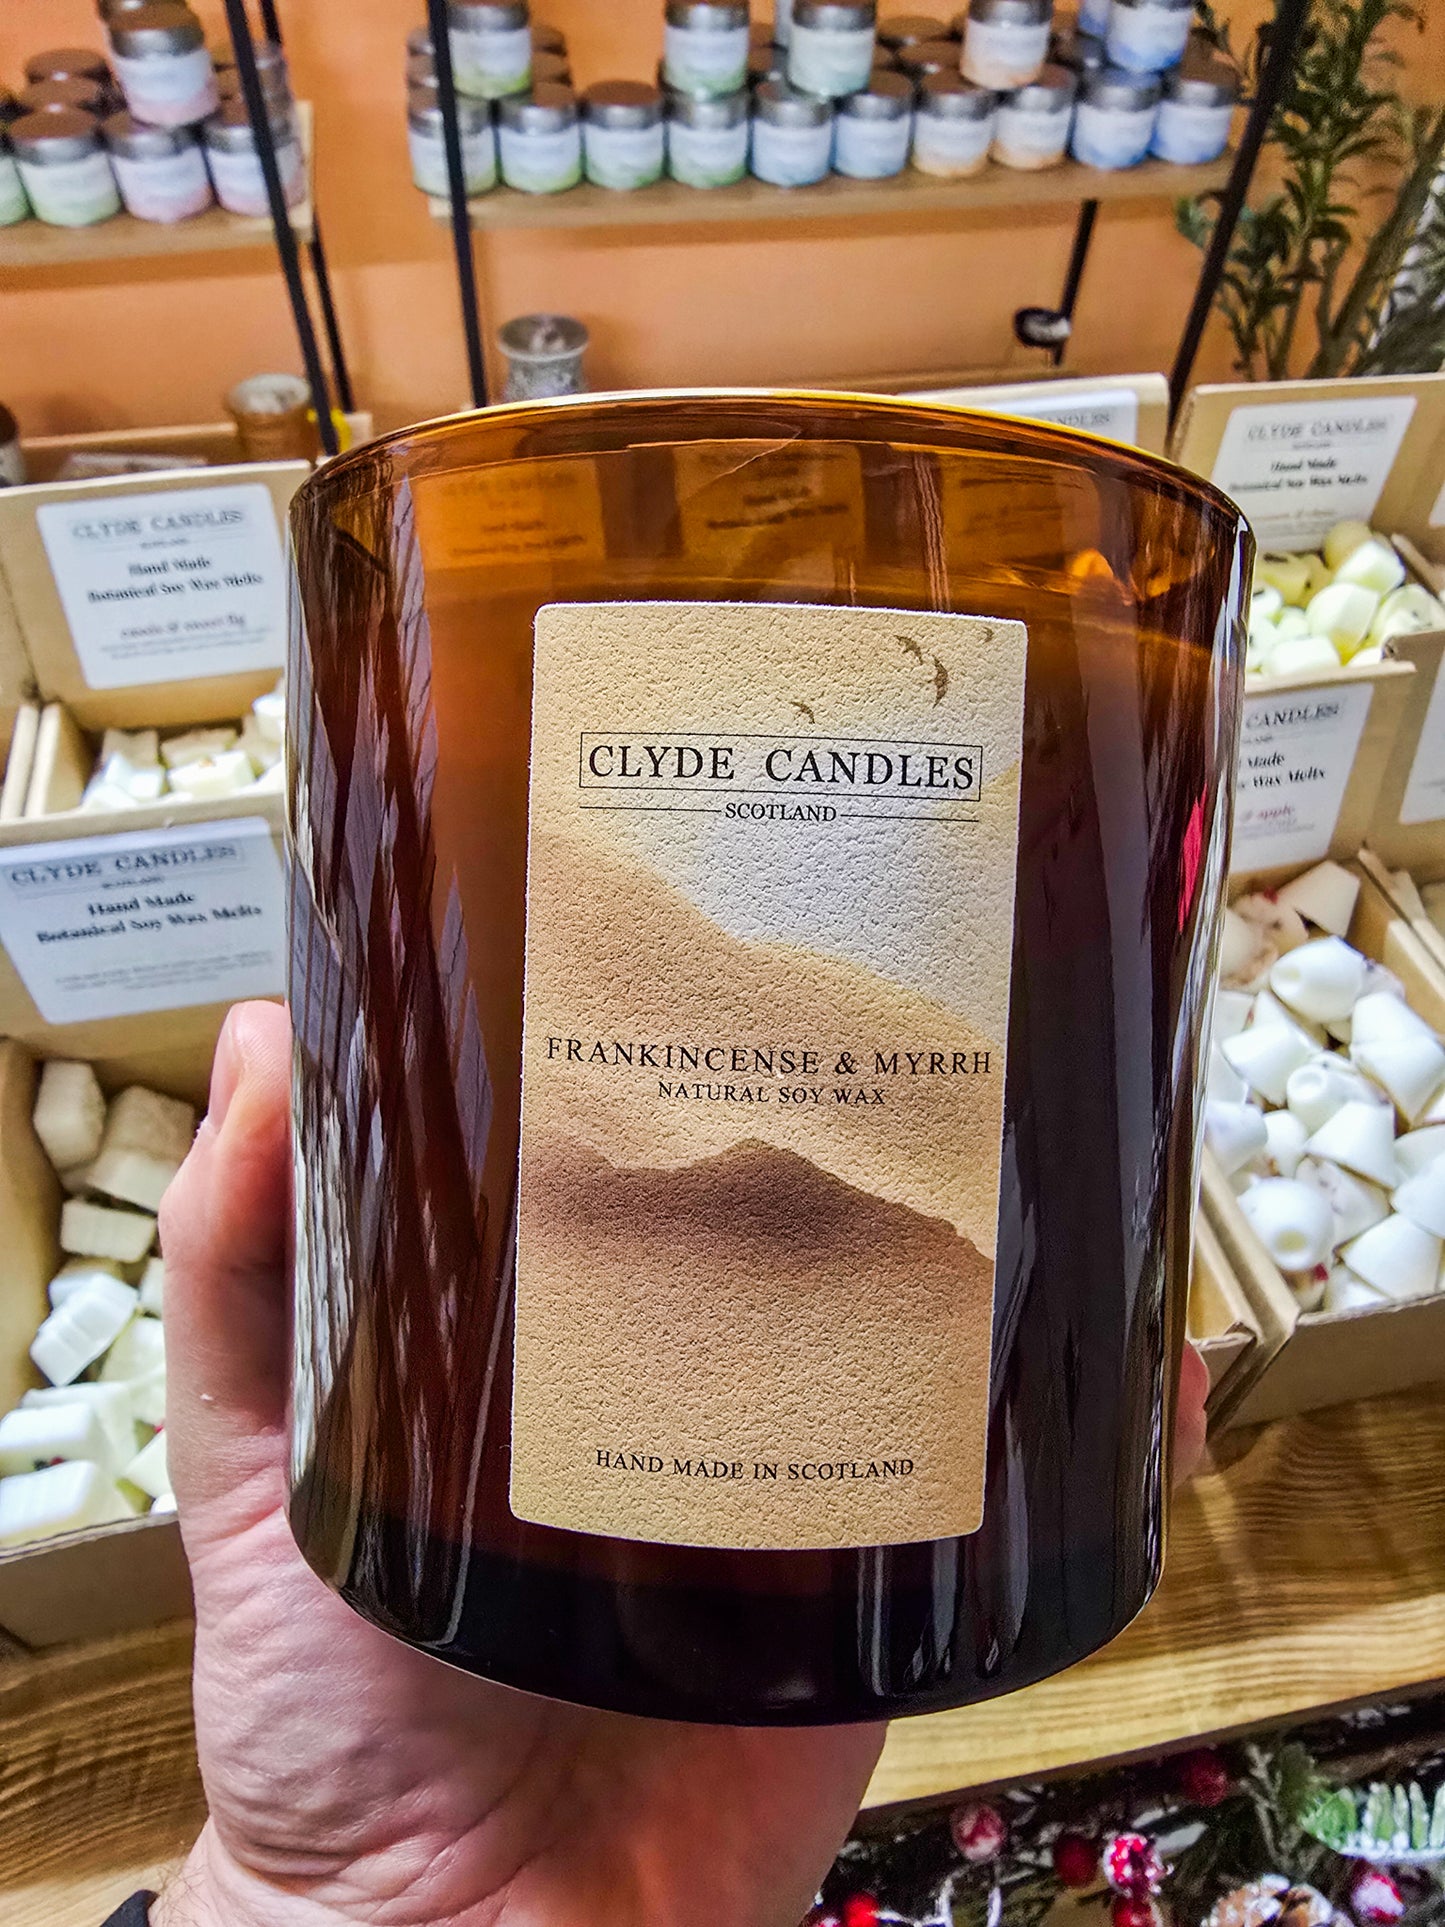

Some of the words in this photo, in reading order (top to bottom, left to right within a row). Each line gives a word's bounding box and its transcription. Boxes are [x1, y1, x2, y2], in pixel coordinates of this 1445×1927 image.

[71, 518, 142, 540] CLYDE
[151, 509, 244, 531] CANDLES
[1245, 702, 1340, 729] CANDLES
[589, 745, 735, 779] CLYDE
[765, 749, 974, 790] CANDLES
[1252, 774, 1281, 789] Wax
[1288, 766, 1326, 783] Melts
[725, 803, 837, 821] SCOTLAND
[11, 861, 102, 885] CLYDE
[114, 844, 237, 871] CANDLES
[88, 898, 140, 917] Hand
[148, 891, 196, 909] Made
[36, 920, 126, 944] Botanical
[212, 904, 262, 920] Melts
[547, 1036, 819, 1074] FRANKINCENSE
[834, 1051, 858, 1075] &
[875, 1051, 992, 1075] MYRRH
[658, 1081, 770, 1103] NATURAL
[779, 1086, 823, 1104] SOY
[833, 1088, 886, 1105] WAX
[596, 1449, 664, 1473] HAND
[673, 1458, 744, 1480] MADE
[753, 1463, 778, 1480] IN
[787, 1458, 914, 1480] SCOTLAND
